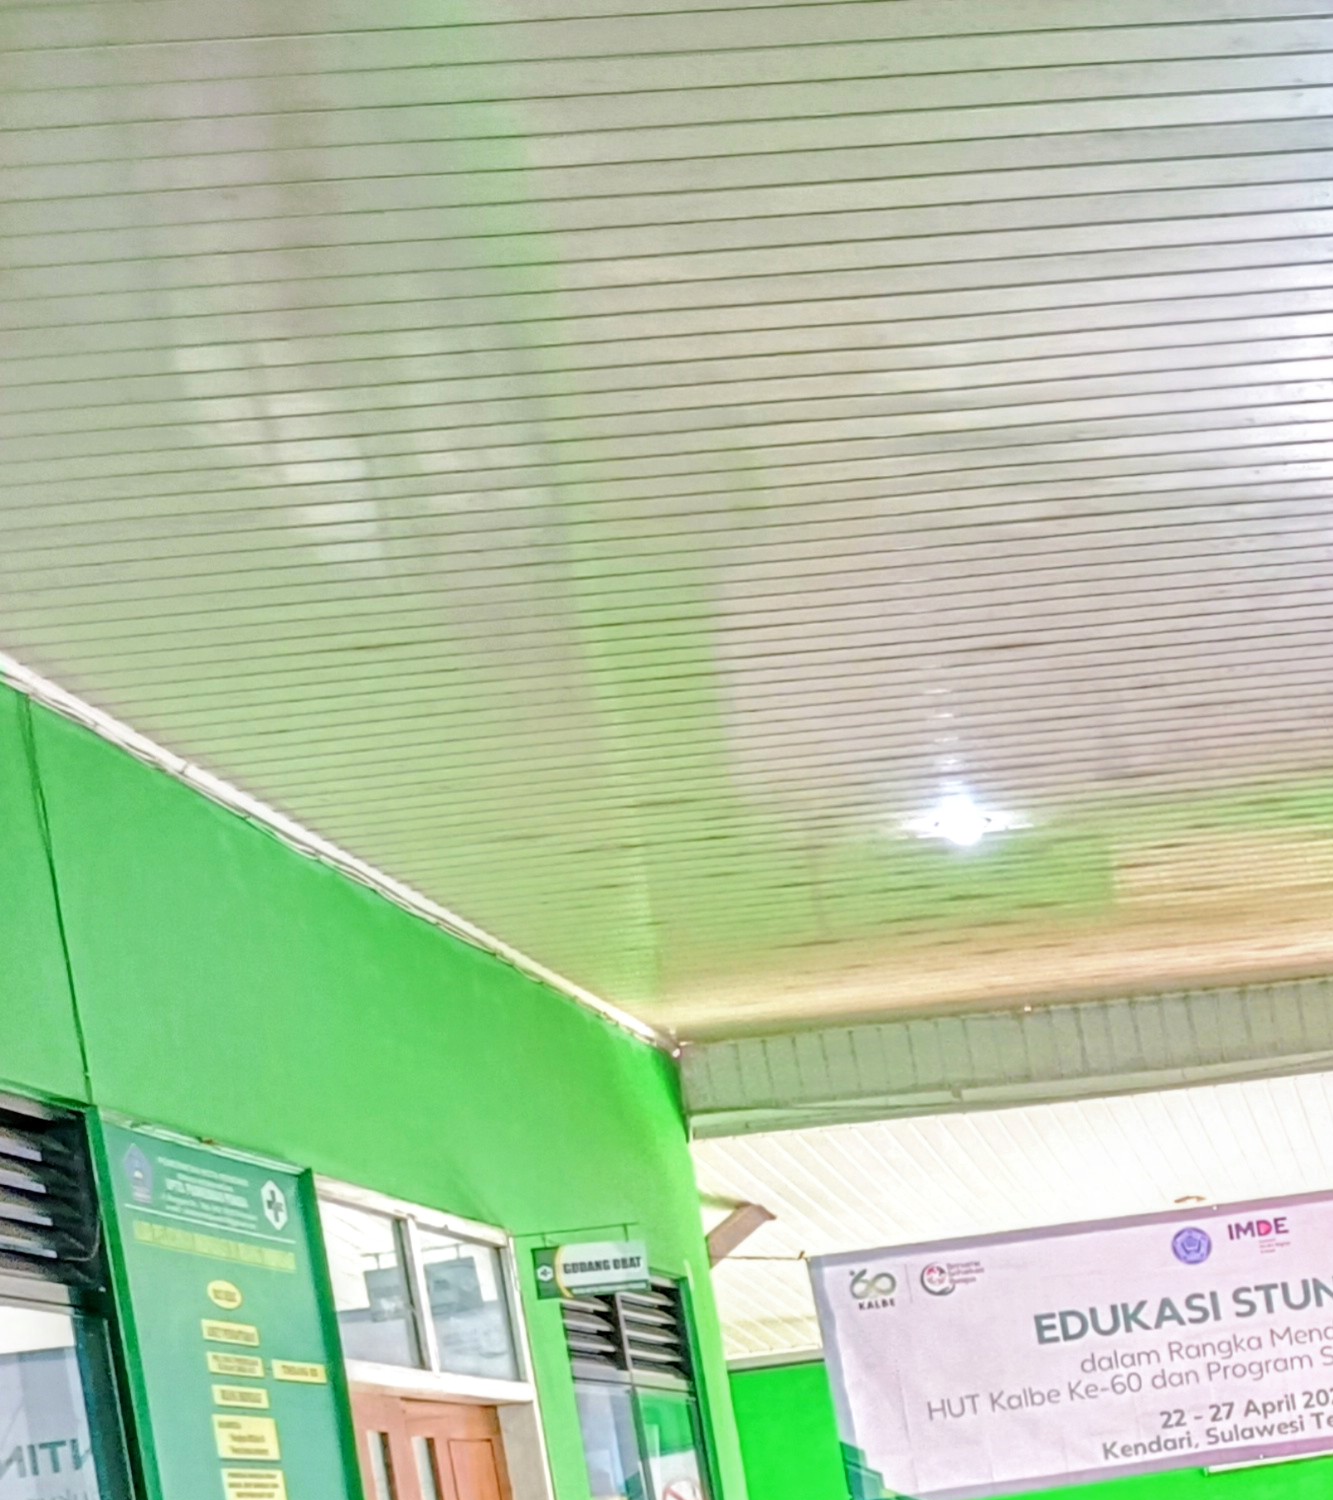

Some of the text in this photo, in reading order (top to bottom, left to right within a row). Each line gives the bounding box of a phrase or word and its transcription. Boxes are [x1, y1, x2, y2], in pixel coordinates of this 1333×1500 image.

[1227, 1216, 1290, 1241] IMDE
[858, 1299, 896, 1310] KALBE
[1033, 1290, 1222, 1345] EDUKASI
[1079, 1349, 1161, 1374] dalam
[1168, 1331, 1263, 1363] Rangka
[926, 1394, 981, 1421] HUT
[989, 1386, 1062, 1413] Kalbe
[1068, 1372, 1144, 1401] Ke-60
[1151, 1367, 1200, 1390] dan
[1206, 1356, 1314, 1382] Program
[1159, 1409, 1188, 1430] 22
[1208, 1402, 1236, 1423] 27
[1243, 1393, 1298, 1420] April
[1101, 1430, 1200, 1461] Kendari,
[1205, 1409, 1306, 1447] Sulawesi
